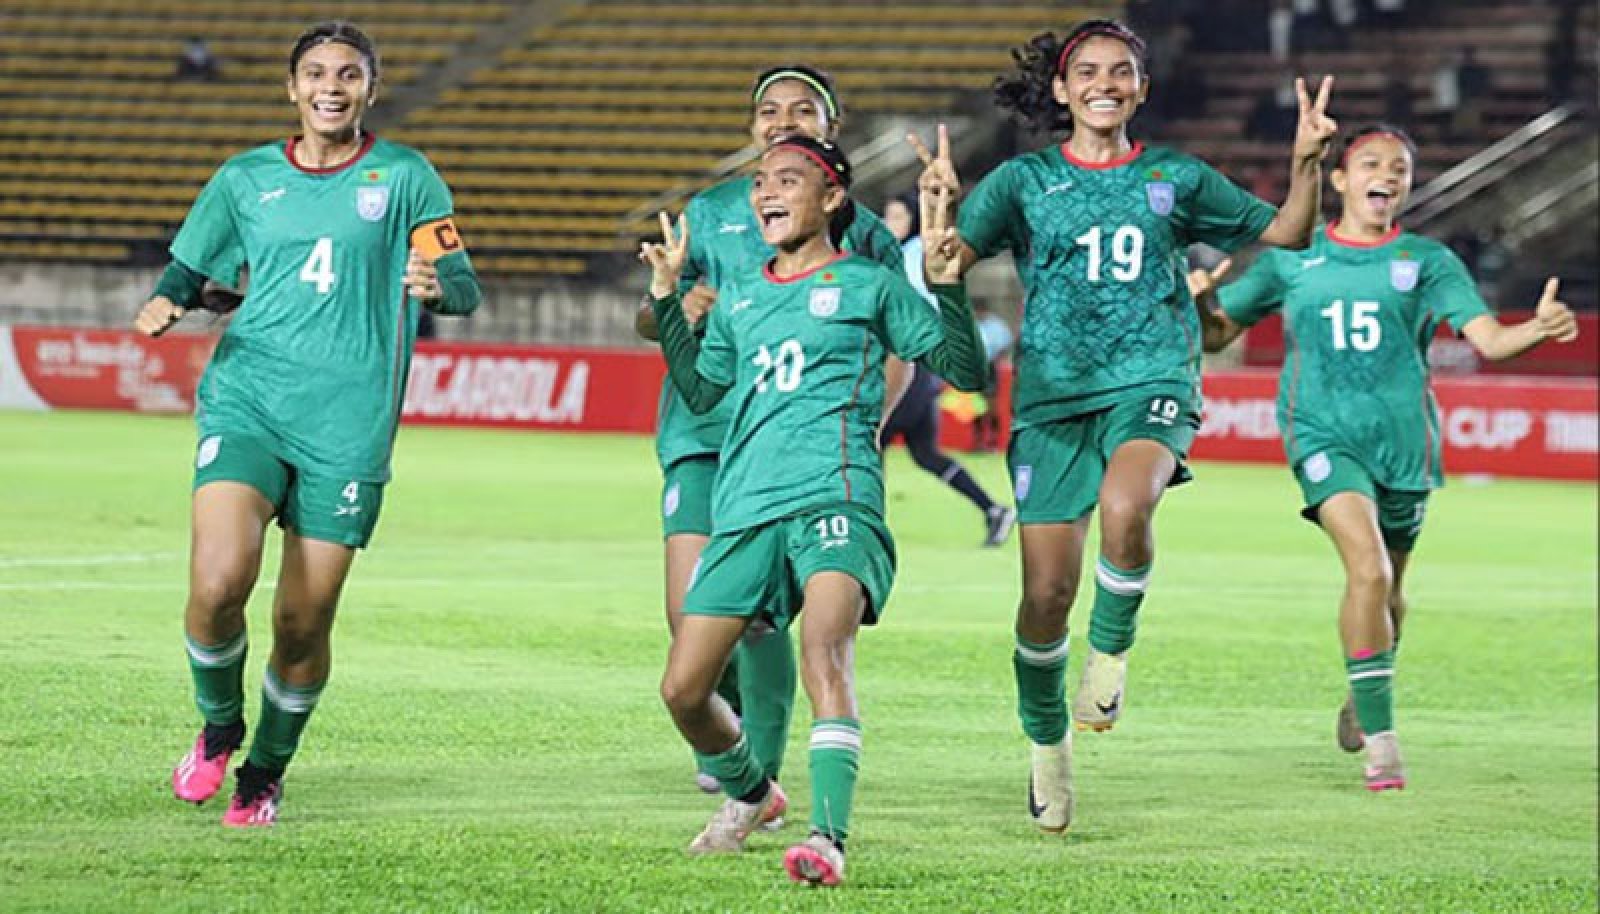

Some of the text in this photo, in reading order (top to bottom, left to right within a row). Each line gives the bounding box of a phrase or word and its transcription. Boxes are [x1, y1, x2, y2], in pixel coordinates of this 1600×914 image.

[434, 223, 459, 250] C
[1076, 225, 1144, 281] 19
[300, 238, 335, 294] 4
[1321, 299, 1381, 351] 15
[752, 339, 805, 393] 10
[1449, 407, 1532, 449] CUP
[341, 481, 359, 503] 4
[815, 515, 849, 538] 10
